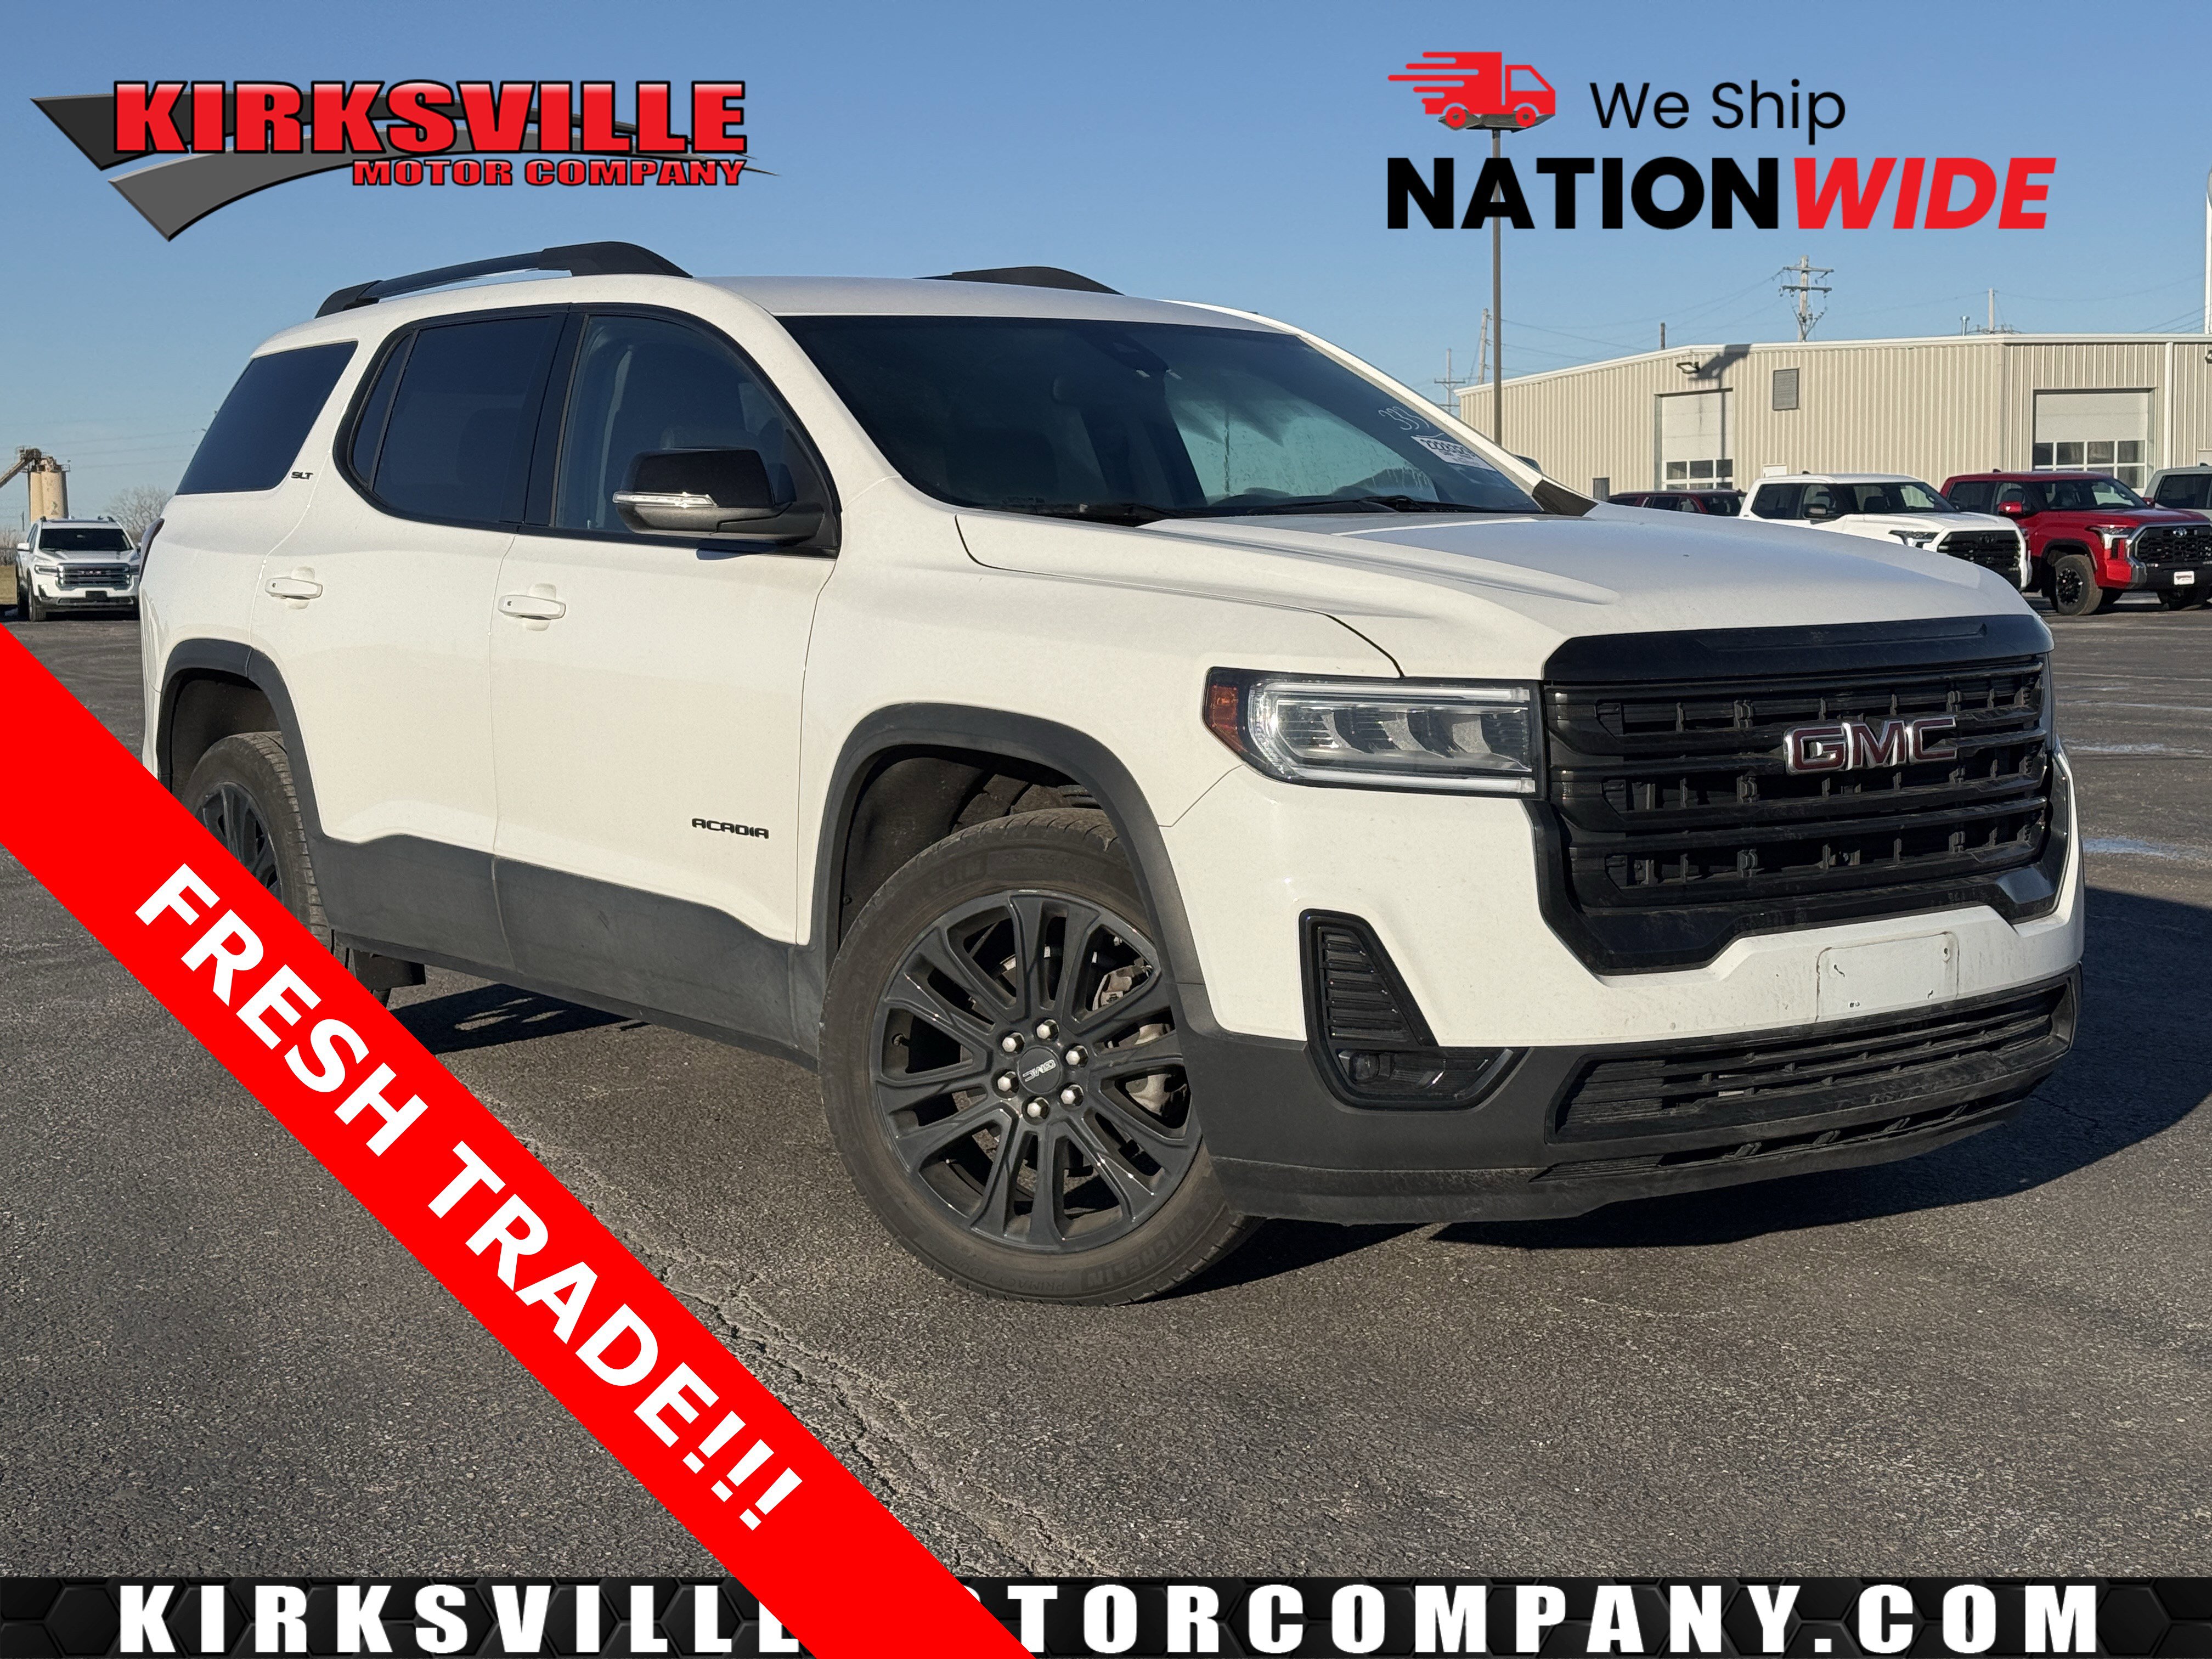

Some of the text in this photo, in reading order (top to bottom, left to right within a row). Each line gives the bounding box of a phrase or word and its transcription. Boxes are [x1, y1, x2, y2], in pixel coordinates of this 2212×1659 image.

[291, 471, 314, 480] SLT
[1784, 715, 1957, 776] GMC
[691, 818, 769, 839] ACADIA
[1022, 1059, 1056, 1082] GMC
[1087, 1214, 1196, 1289] MICHELIN
[996, 1276, 1066, 1292] PRIMACY
